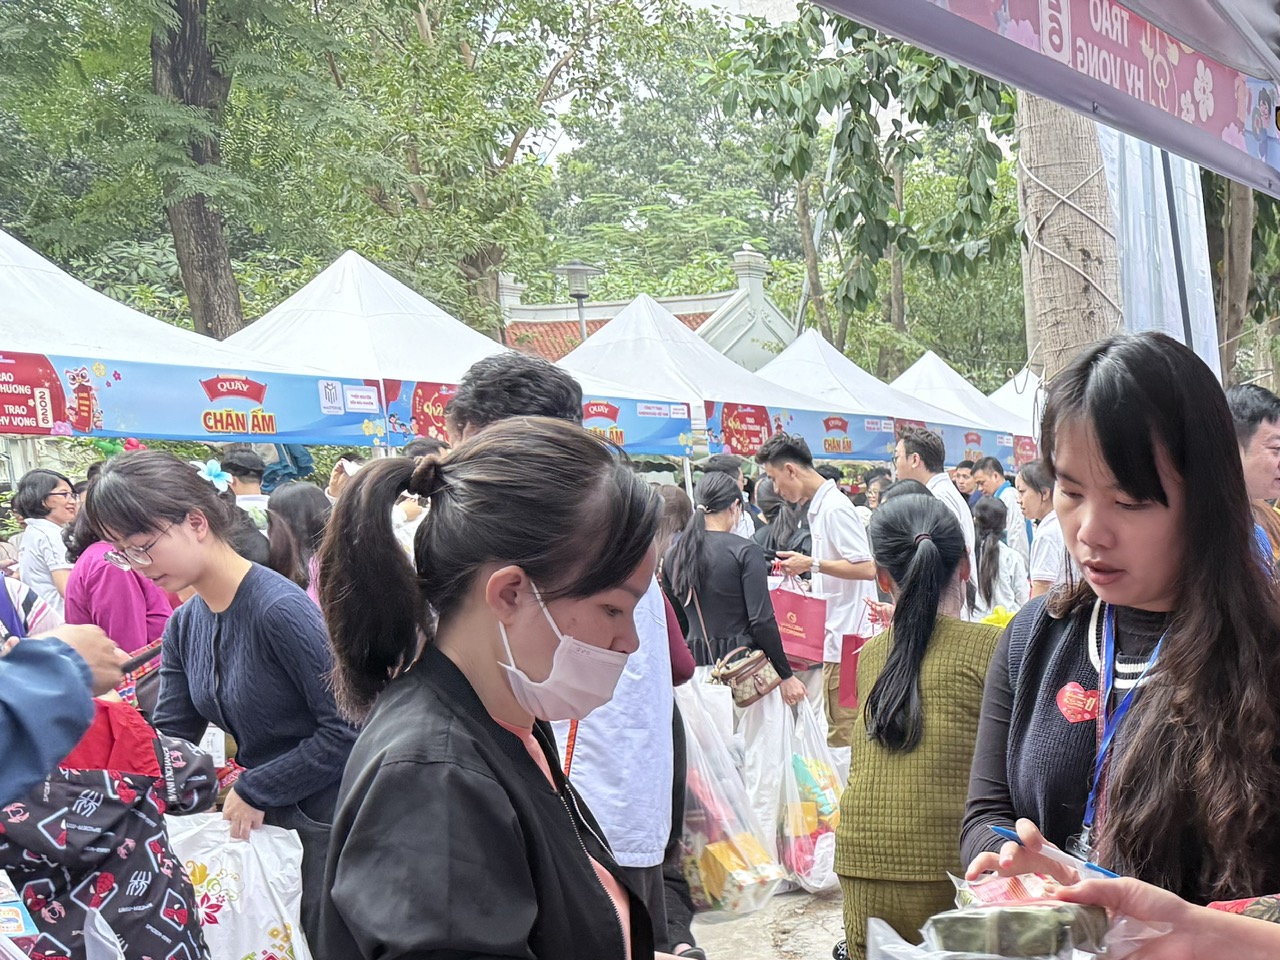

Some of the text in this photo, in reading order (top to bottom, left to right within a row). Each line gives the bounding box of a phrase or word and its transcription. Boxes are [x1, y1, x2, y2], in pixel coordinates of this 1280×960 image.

[0, 372, 14, 382] AO
[3, 404, 27, 415] TRAO
[38, 390, 50, 425] 2026
[203, 409, 247, 433] CHĂN
